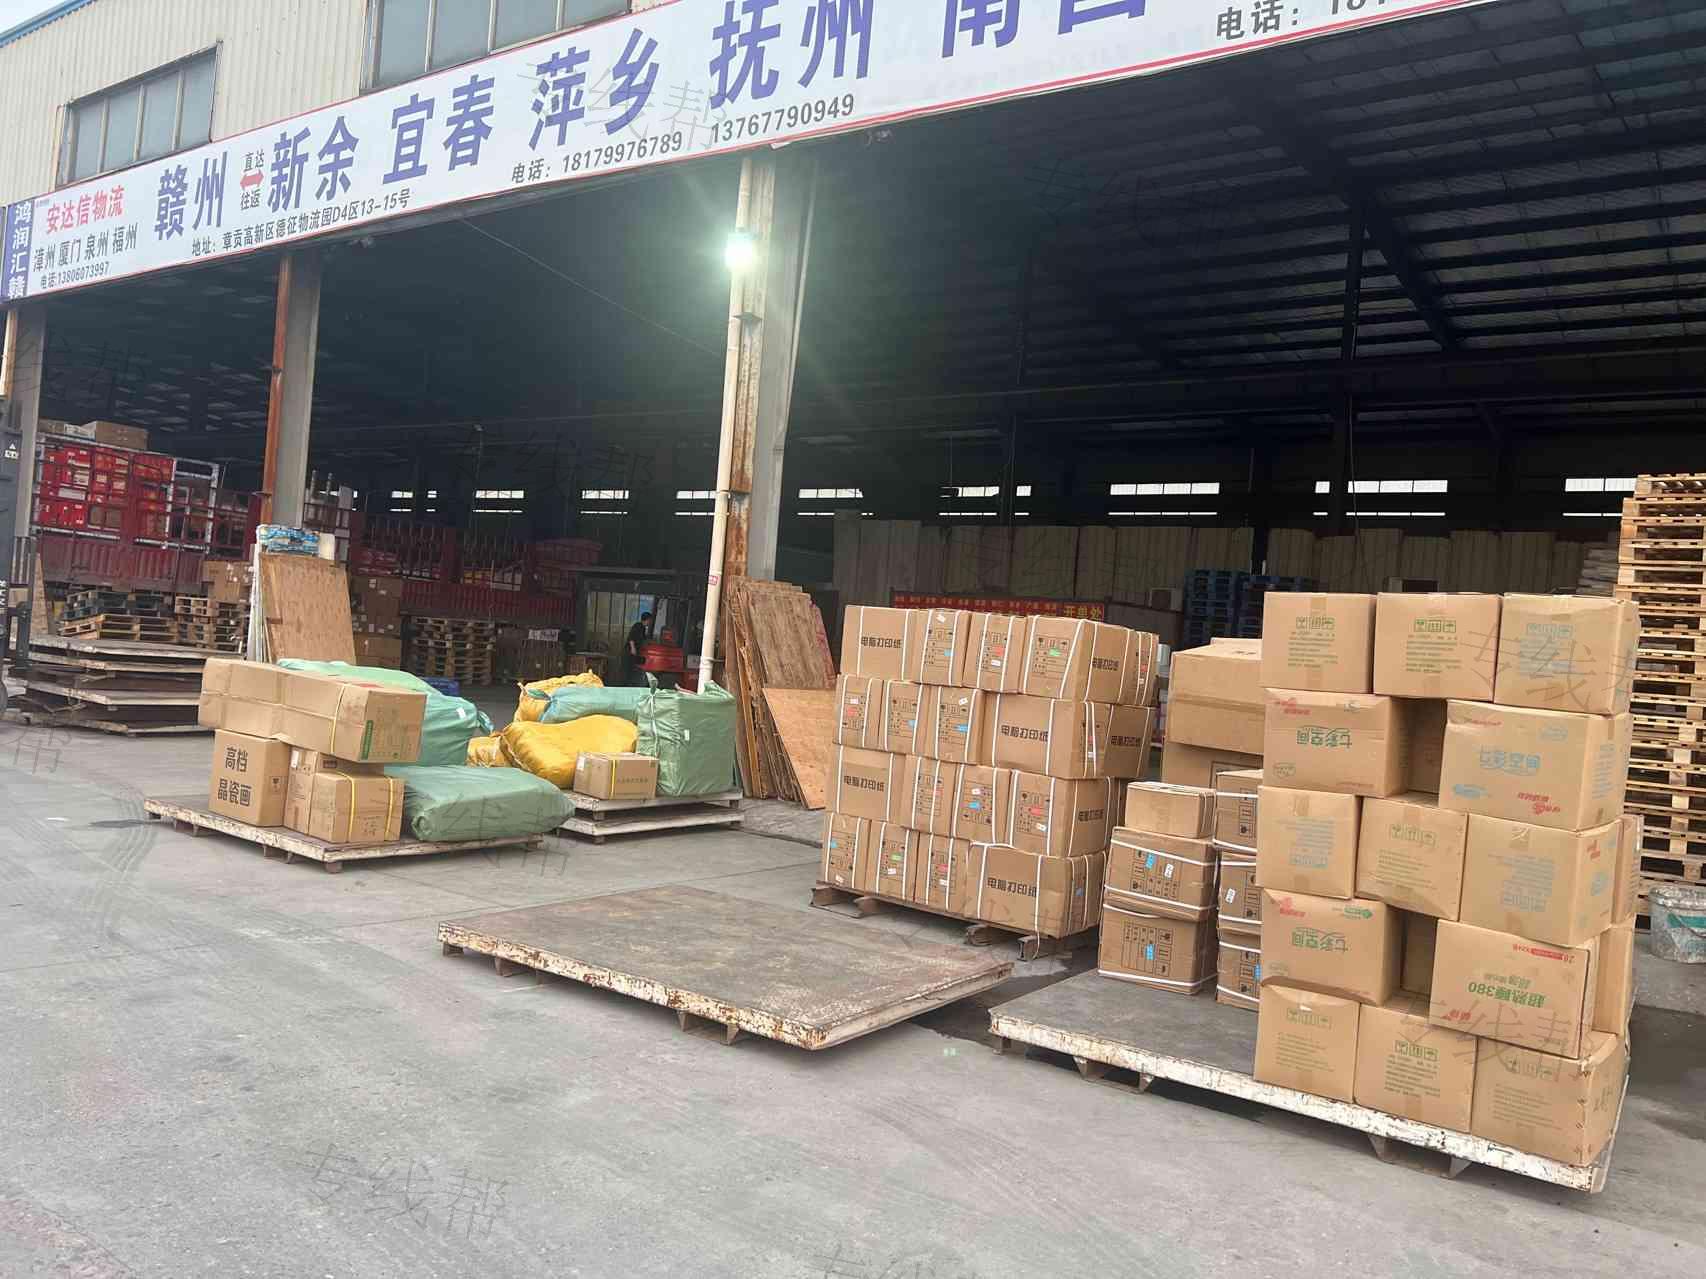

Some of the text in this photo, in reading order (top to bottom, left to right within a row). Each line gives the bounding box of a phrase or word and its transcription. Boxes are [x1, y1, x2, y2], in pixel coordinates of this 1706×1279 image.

[154, 152, 228, 241] 赣州
[267, 115, 360, 213] 新余
[382, 73, 496, 185] 宜春
[528, 28, 660, 151] 萍乡
[709, 0, 874, 110] 抚州
[710, 92, 855, 143] 13767790949
[47, 184, 125, 234] 安达信物流
[861, 636, 902, 649] 电脑打印纸
[1001, 724, 1049, 743] 电脑打印纸
[225, 747, 248, 772] 高档
[843, 775, 885, 792] 电脑打印纸
